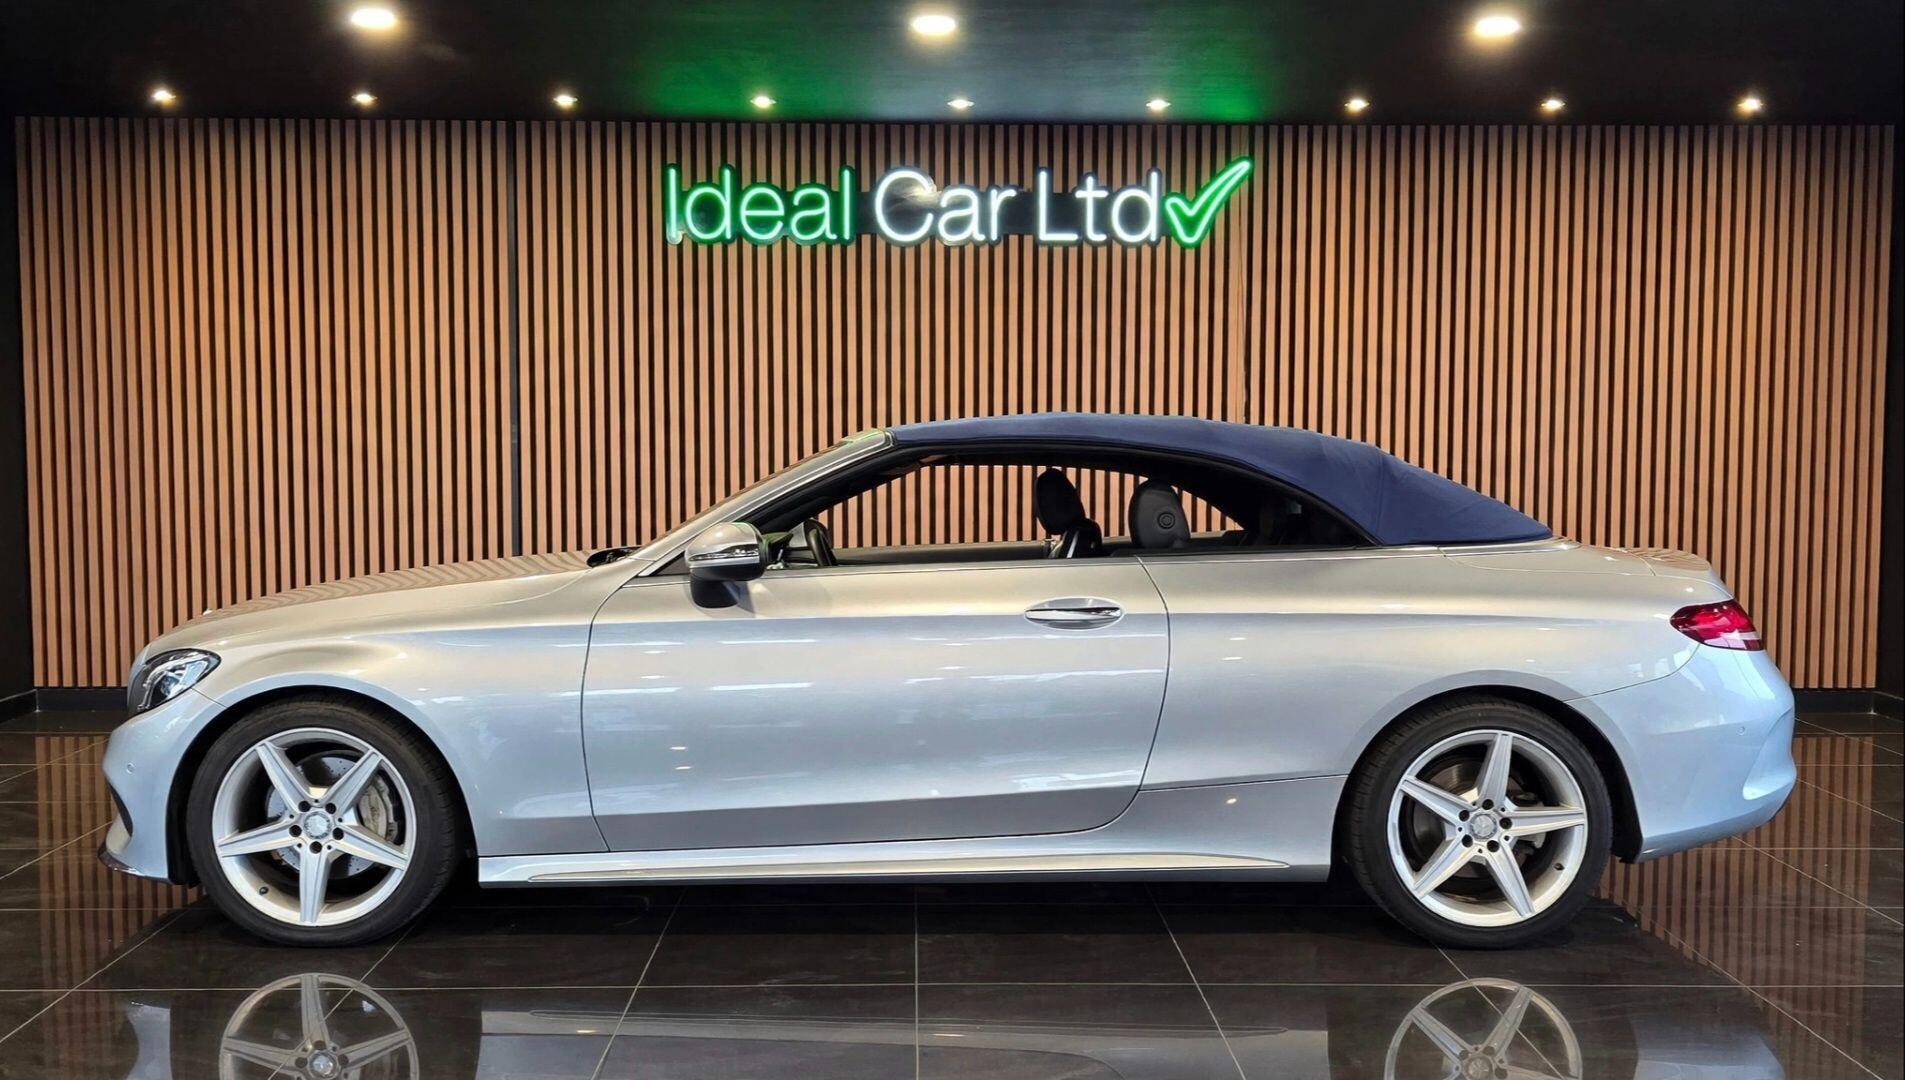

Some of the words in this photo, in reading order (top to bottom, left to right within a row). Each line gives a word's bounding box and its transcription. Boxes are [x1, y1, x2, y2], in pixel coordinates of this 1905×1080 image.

[667, 166, 852, 243] Ideal
[874, 168, 1016, 243] Car
[1037, 168, 1160, 243] Ltd
